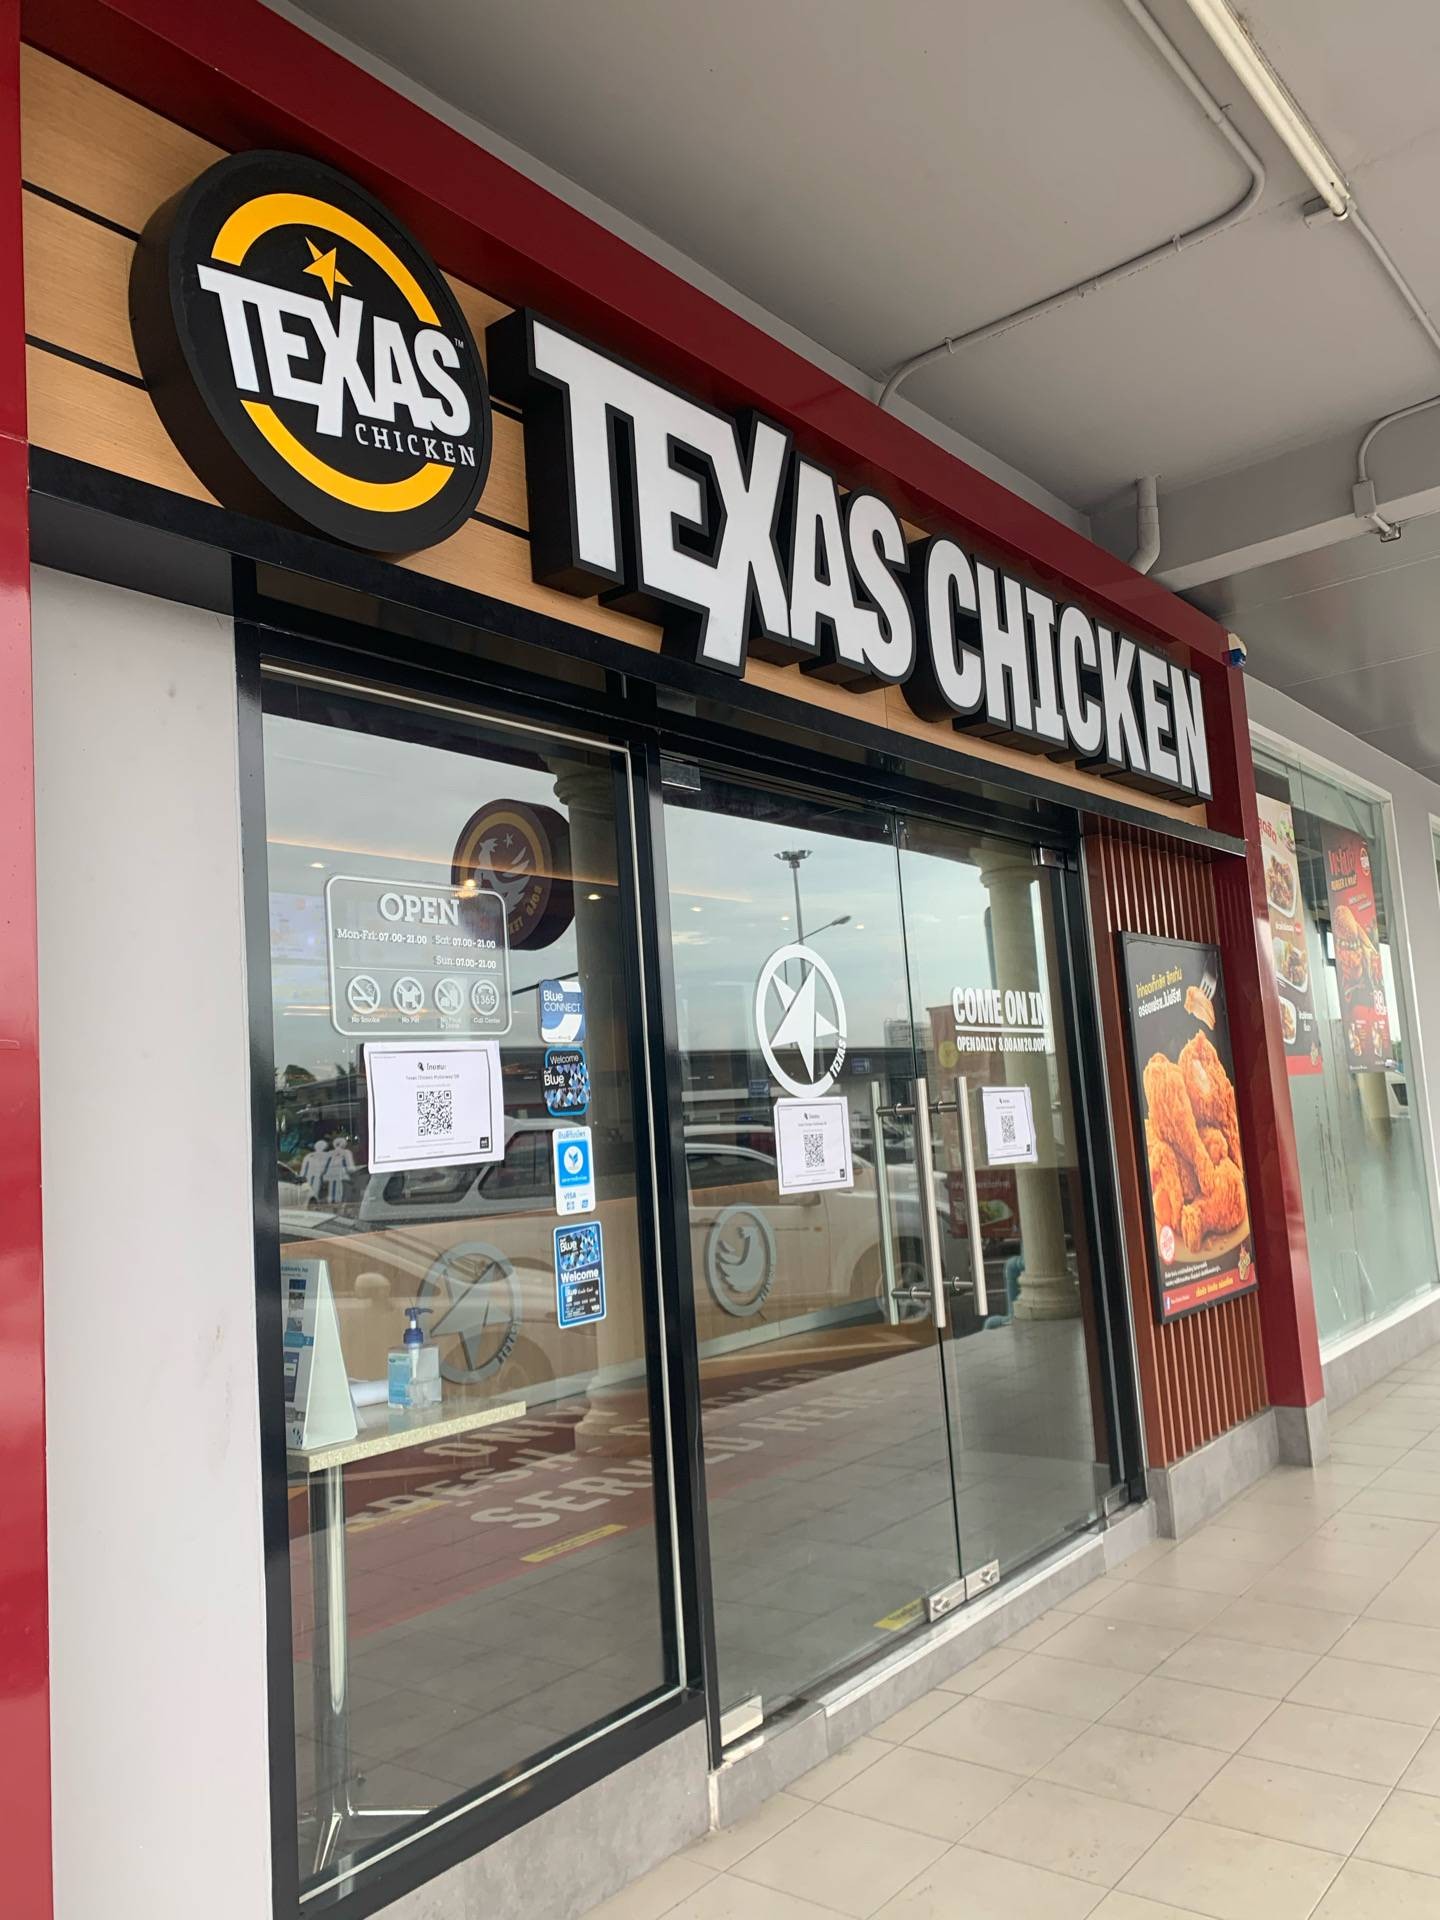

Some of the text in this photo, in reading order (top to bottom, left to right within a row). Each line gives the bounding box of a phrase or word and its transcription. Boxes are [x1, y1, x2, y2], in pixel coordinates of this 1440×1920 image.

[197, 264, 471, 437] TEXAS
[355, 422, 475, 467] CHICKEN
[533, 319, 1212, 799] TEXAS CHICKEN
[380, 892, 459, 926] OPEN
[543, 989, 563, 1001] Blue
[544, 1002, 581, 1013] CONNECT
[952, 986, 1048, 1026] COME ON IN
[957, 1036, 976, 1051] OPEN
[550, 1054, 579, 1065] Welcome
[830, 1038, 847, 1078] TEXAS
[543, 1073, 565, 1086] Blue
[560, 1240, 578, 1253] Blue
[561, 1268, 599, 1284] Welcome
